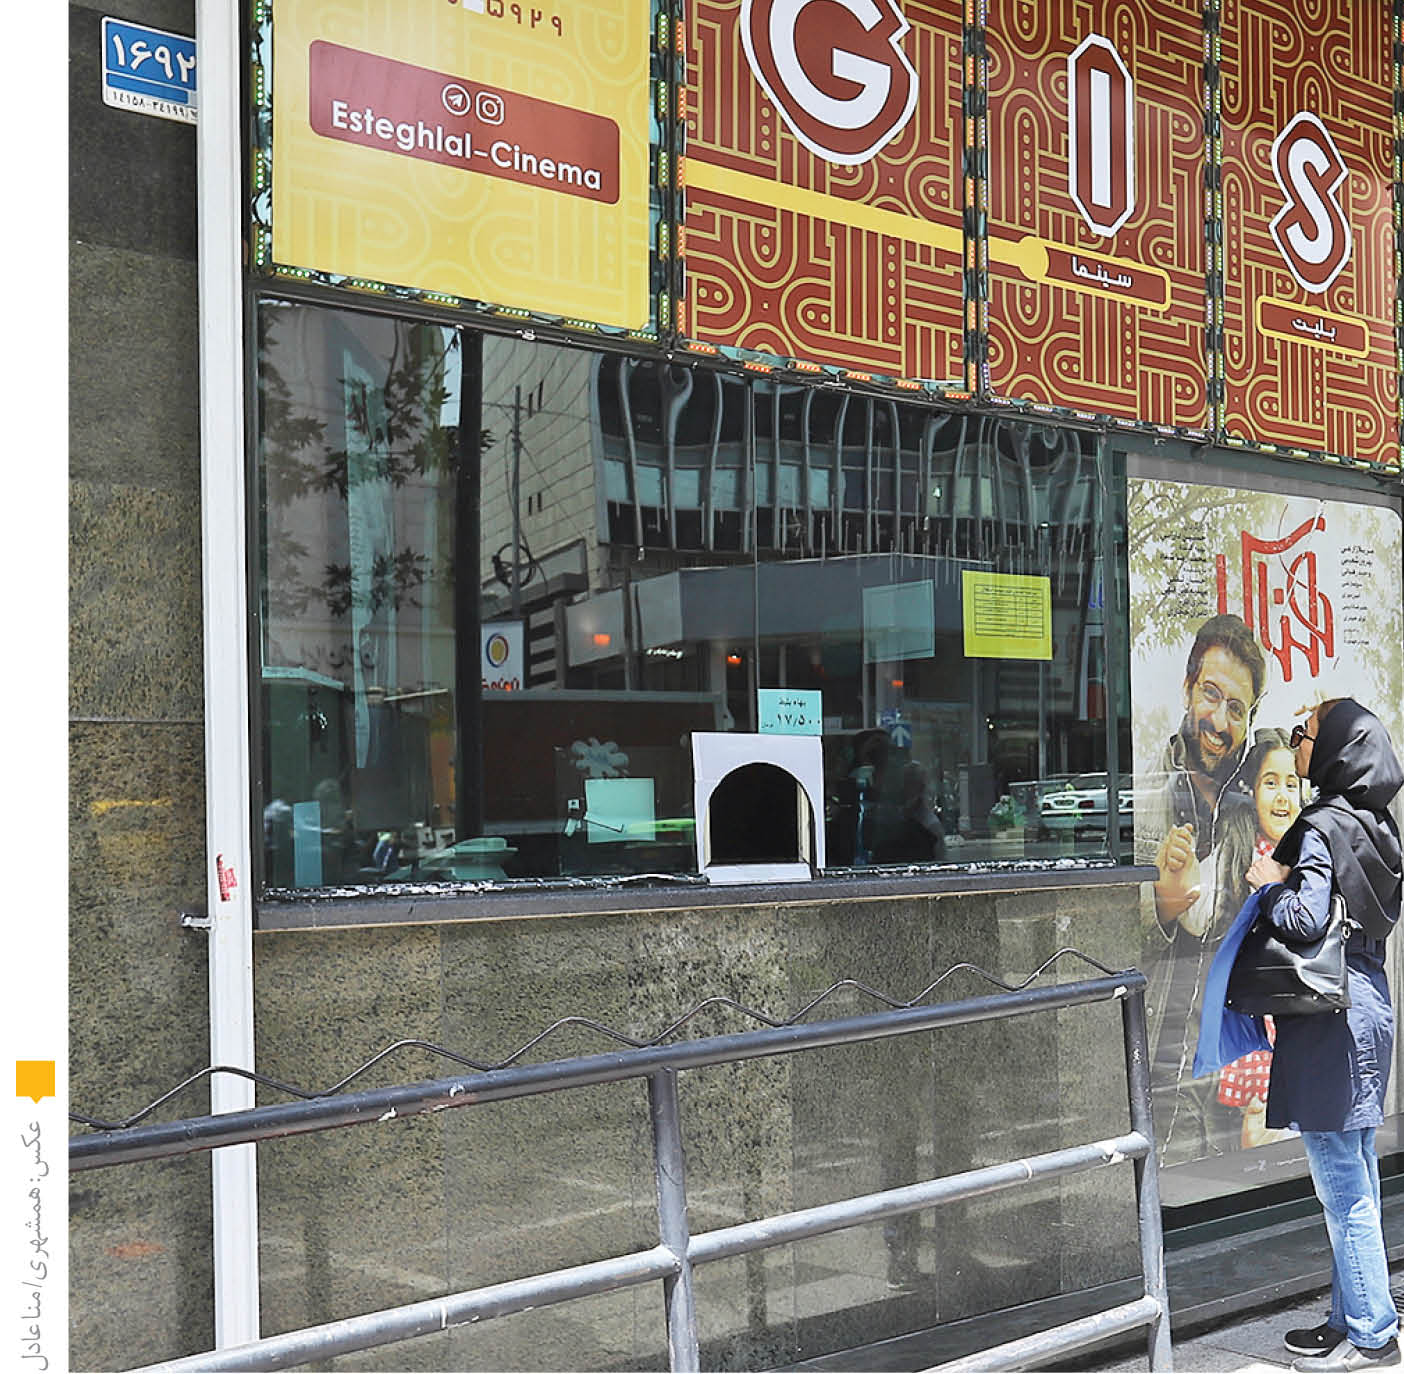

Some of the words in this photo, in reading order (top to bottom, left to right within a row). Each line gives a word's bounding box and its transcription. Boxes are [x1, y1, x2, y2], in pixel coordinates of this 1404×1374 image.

[331, 100, 602, 191] Esteghlal-Cinema
[1072, 255, 1132, 288] سینما
[1291, 318, 1336, 342] بلیت
